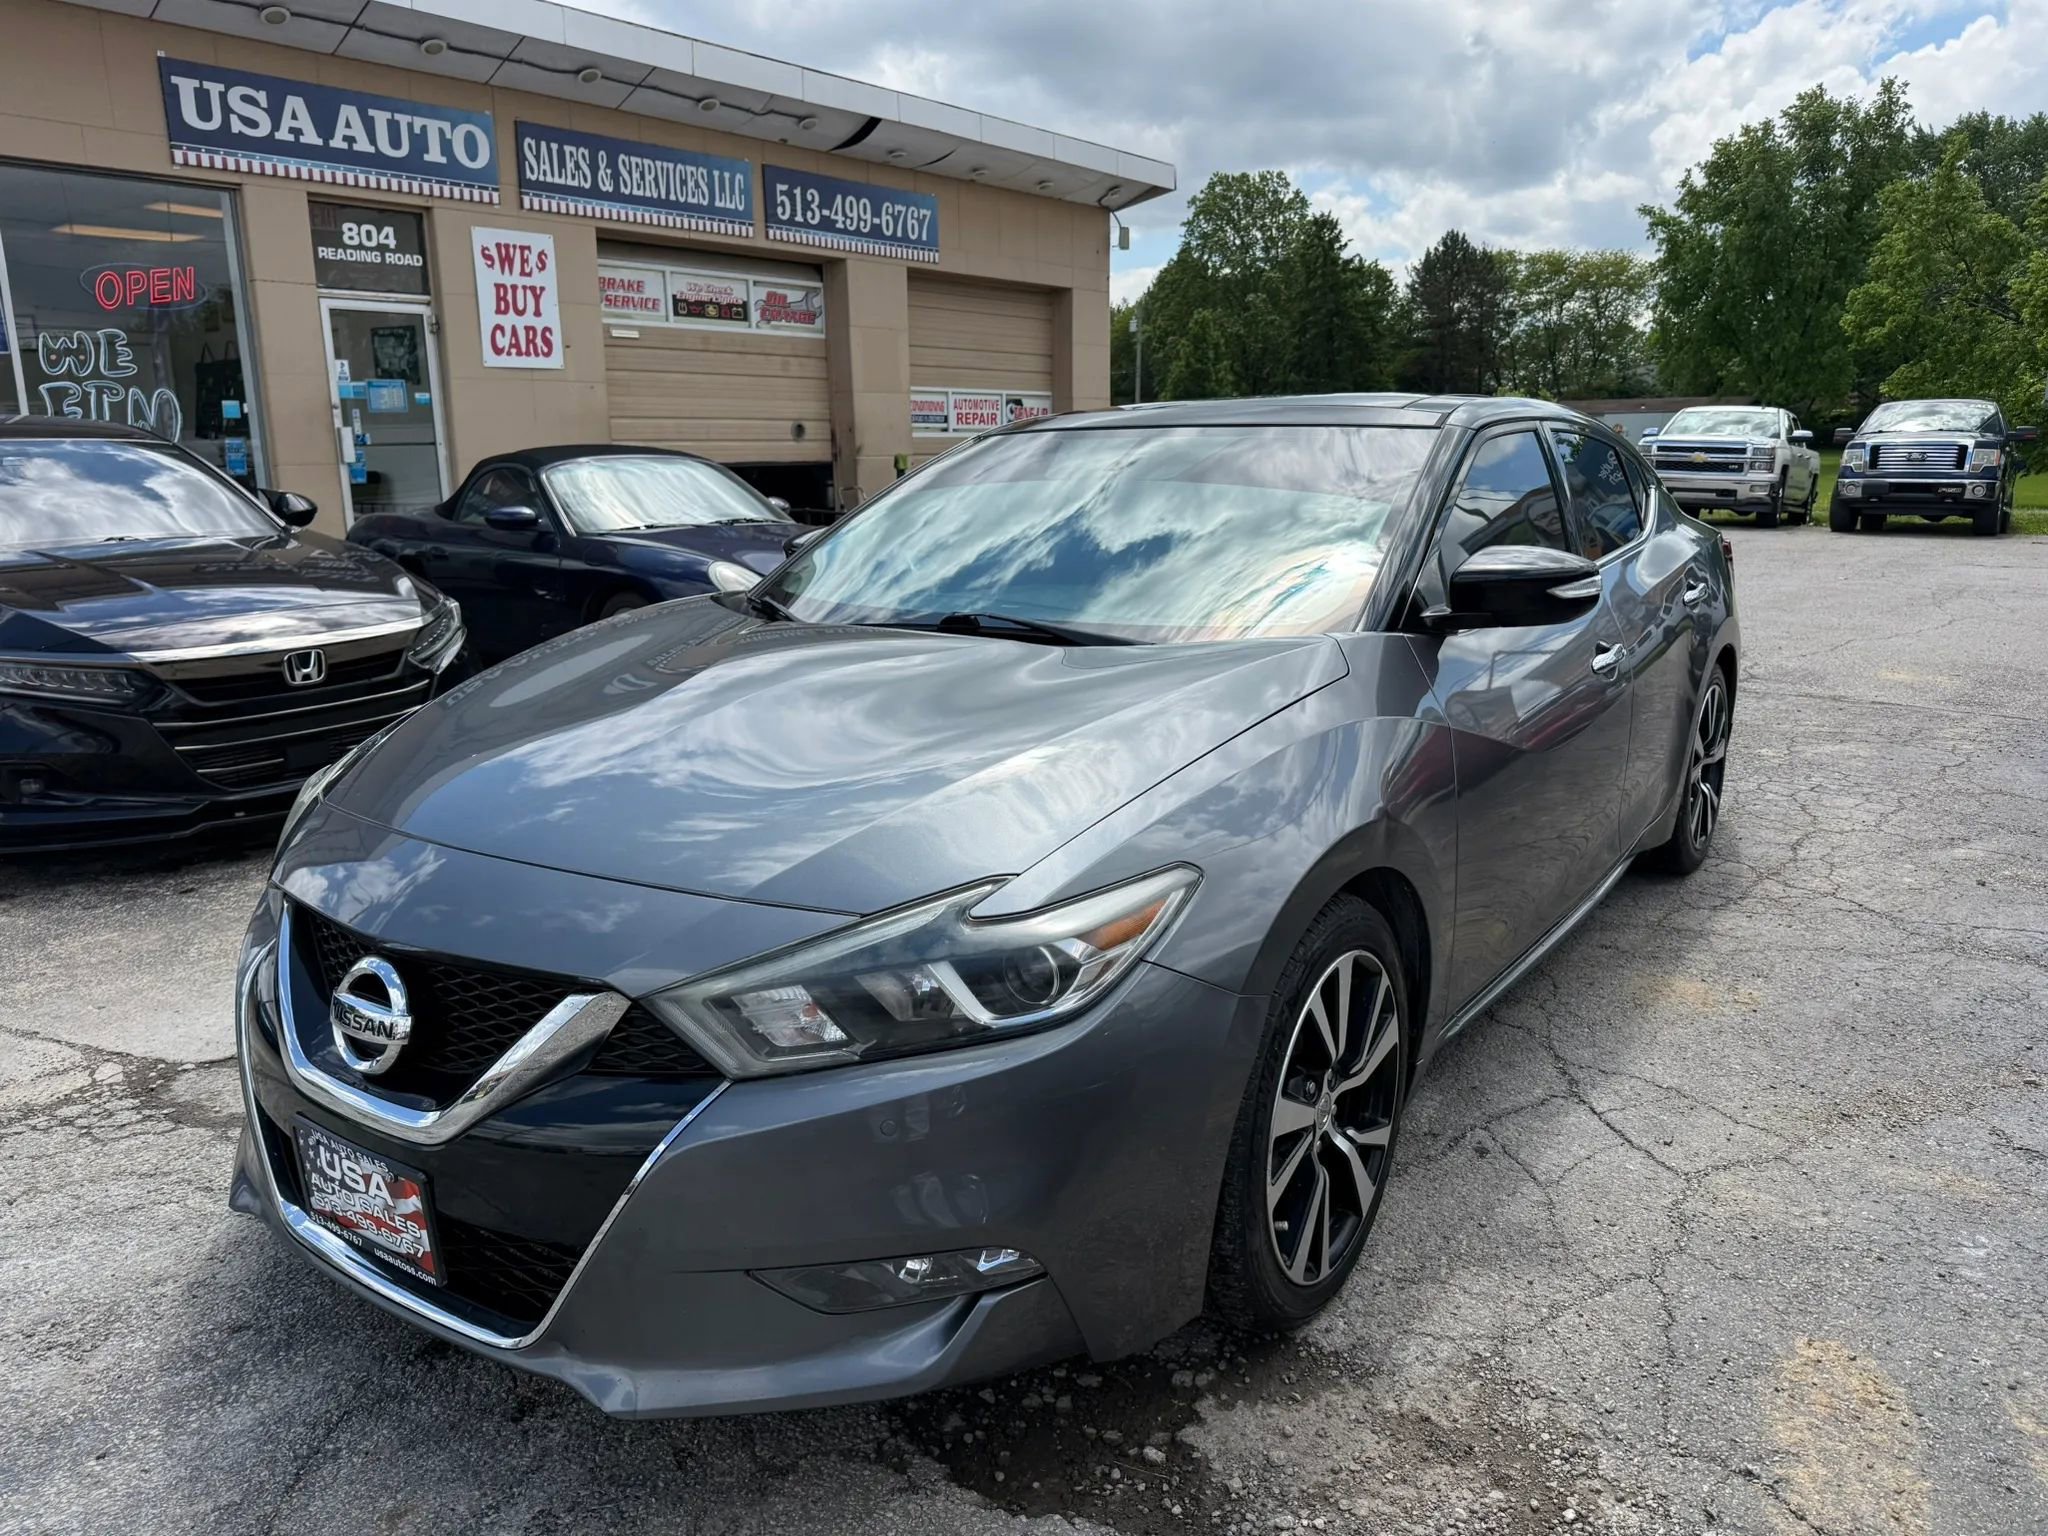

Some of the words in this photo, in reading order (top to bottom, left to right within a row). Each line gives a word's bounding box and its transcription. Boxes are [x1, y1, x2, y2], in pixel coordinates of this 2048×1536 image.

[170, 75, 323, 146] USA
[329, 104, 491, 169] AUTO
[523, 137, 591, 189] SALES
[598, 150, 613, 193] &
[618, 153, 709, 206] SERVICES
[712, 170, 745, 211] LLC
[775, 183, 932, 242] 513-499-6767
[317, 246, 382, 263] READING
[385, 252, 423, 267] ROAD
[342, 222, 396, 249] 804
[95, 266, 196, 311] OPEN
[494, 282, 546, 318] BUY
[599, 276, 646, 294] BRAKE
[604, 294, 661, 312] SERVICE
[38, 329, 138, 377] WE
[490, 323, 553, 358] CARS
[953, 398, 1000, 412] AUTOMOTIVE
[956, 412, 998, 426] REPAIR
[332, 1000, 395, 1040] NISSAN
[311, 1129, 329, 1147] USA
[330, 1140, 356, 1159] AUTO
[355, 1152, 389, 1173] SALES
[319, 1145, 396, 1208] USA
[311, 1172, 356, 1206] AUTO
[359, 1195, 422, 1239] SALES
[310, 1211, 363, 1247] 513-499-6767
[373, 1247, 437, 1287] usaautoss.com
